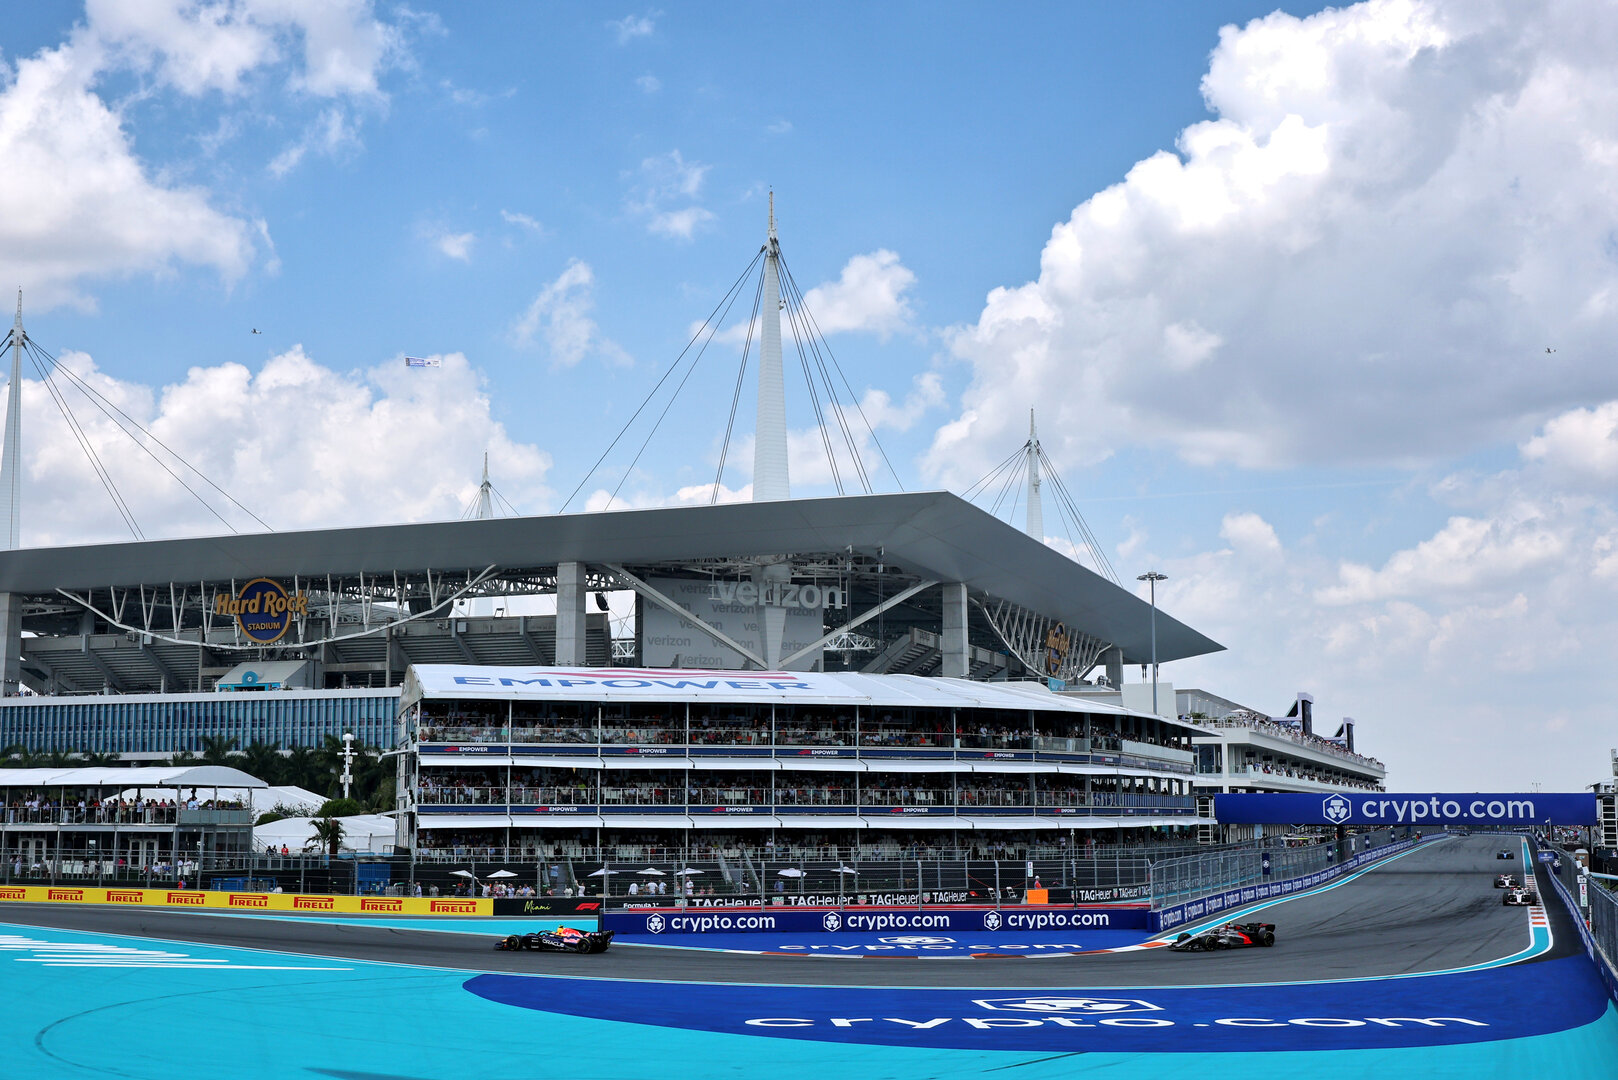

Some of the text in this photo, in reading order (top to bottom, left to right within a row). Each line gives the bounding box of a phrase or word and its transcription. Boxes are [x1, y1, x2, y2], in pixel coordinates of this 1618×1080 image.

[716, 580, 842, 609] verizon
[216, 589, 308, 617] Hard Rock
[247, 622, 281, 630] STADIUM
[647, 635, 691, 647] verizon
[453, 676, 817, 690] EMPOWER
[1361, 797, 1535, 822] crypto.com
[48, 889, 83, 901] PIRELLI
[106, 890, 143, 902] PIRELLI
[167, 892, 205, 904] PIRELLI
[229, 894, 268, 907] PIRELLI
[293, 896, 334, 909] PIRELLI
[361, 898, 403, 911] PIRELLI
[430, 900, 477, 913] PIRELLI
[524, 900, 551, 913] Miami
[671, 914, 775, 931] crypto.com
[847, 913, 950, 930] crypto.com
[1007, 911, 1109, 929] crypto.com
[541, 938, 565, 947] ORACLE
[744, 1017, 1490, 1029] crypto.com
